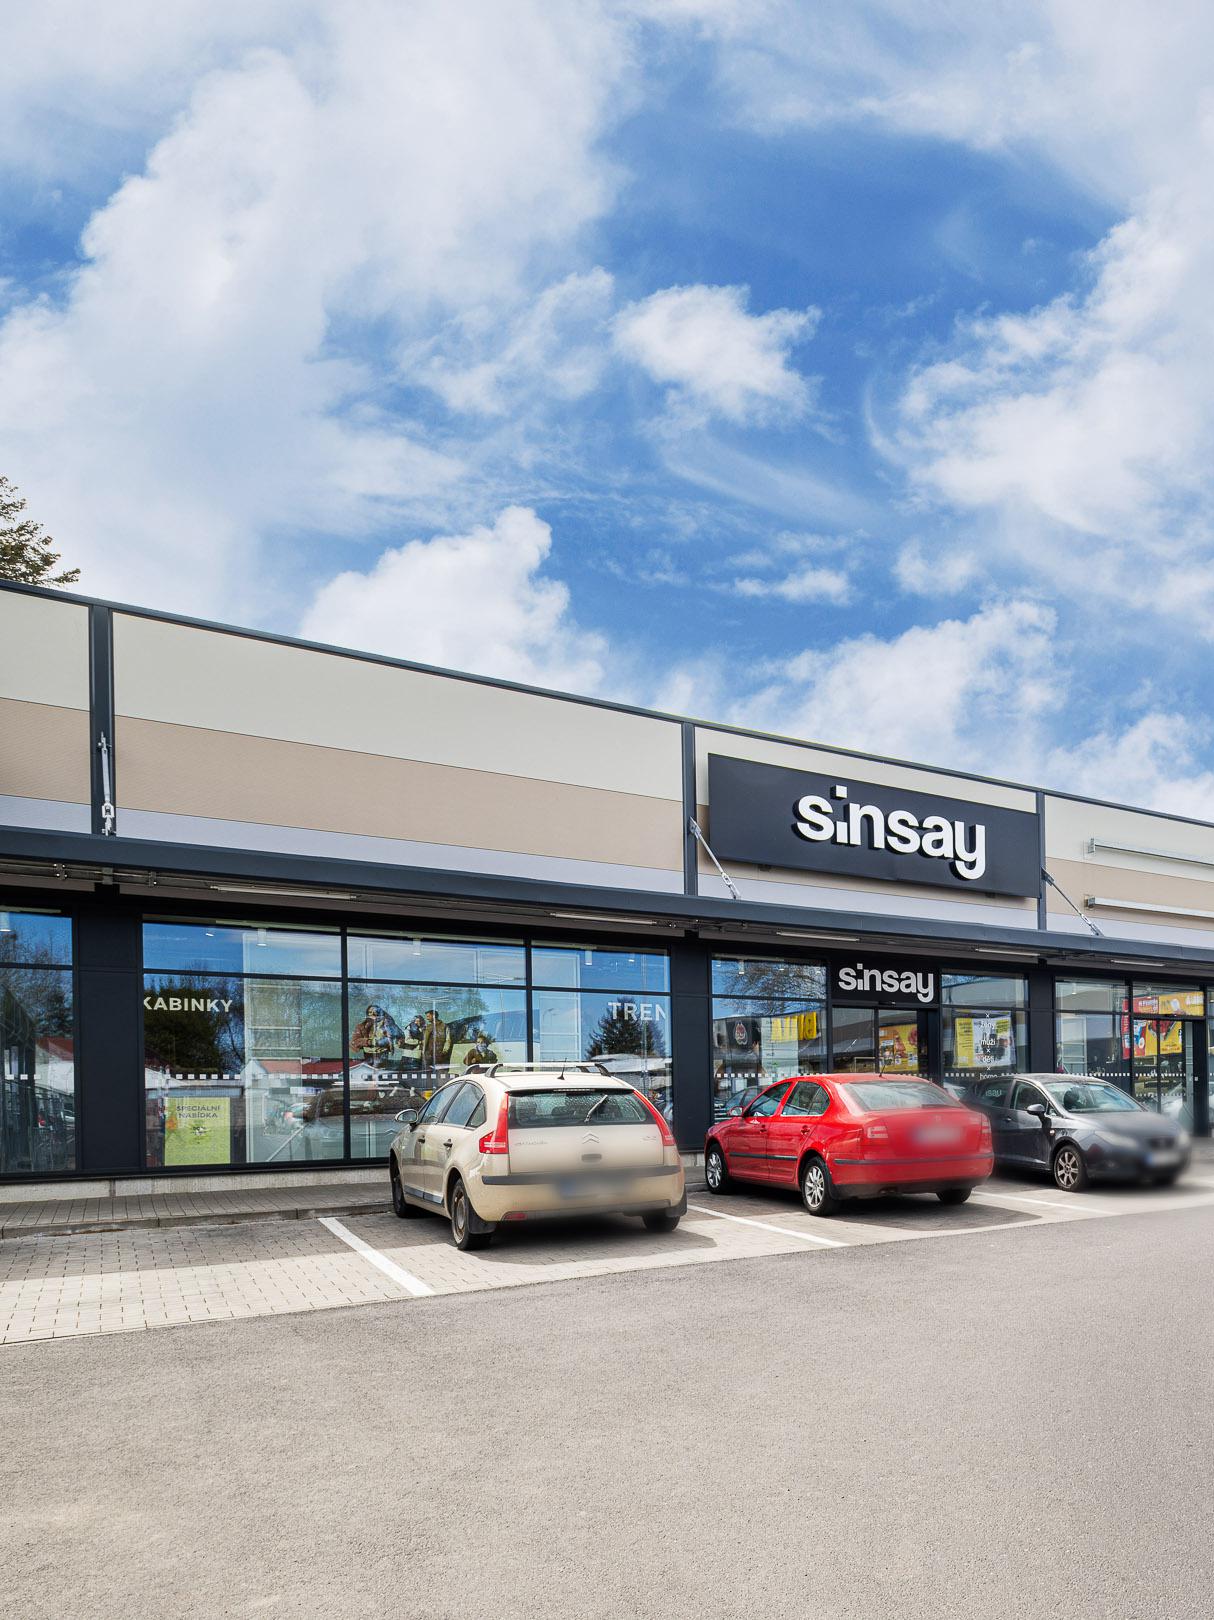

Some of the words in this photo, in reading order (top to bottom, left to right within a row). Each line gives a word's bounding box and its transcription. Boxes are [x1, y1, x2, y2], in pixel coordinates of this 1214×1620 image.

[797, 785, 986, 880] sinsay
[838, 963, 934, 1003] sinsay
[143, 997, 233, 1013] KABINKY
